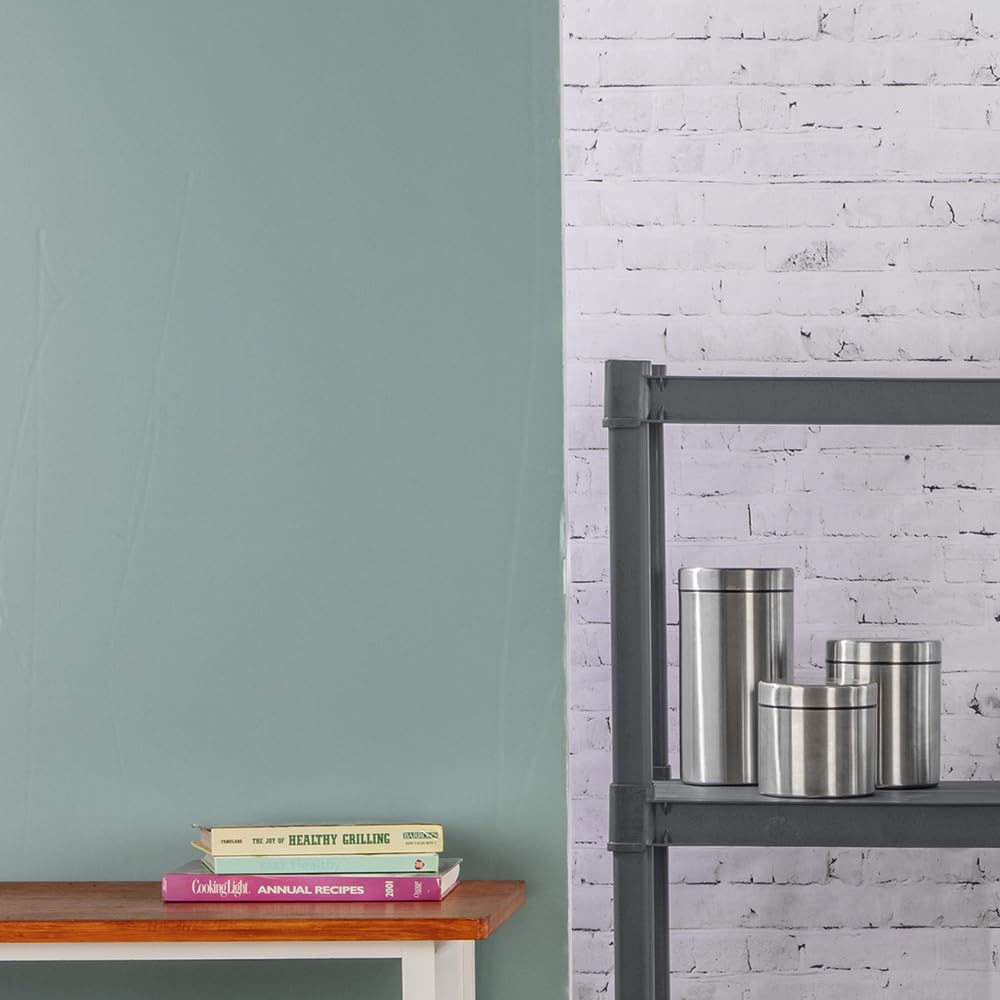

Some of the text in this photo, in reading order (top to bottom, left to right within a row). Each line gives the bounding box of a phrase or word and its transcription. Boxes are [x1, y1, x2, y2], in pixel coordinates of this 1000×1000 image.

[288, 834, 338, 846] HEALTHY
[342, 833, 390, 845] GRILLING
[257, 885, 312, 894] ANNUAL
[314, 885, 365, 894] RECIPES
[385, 880, 394, 898] 2001
